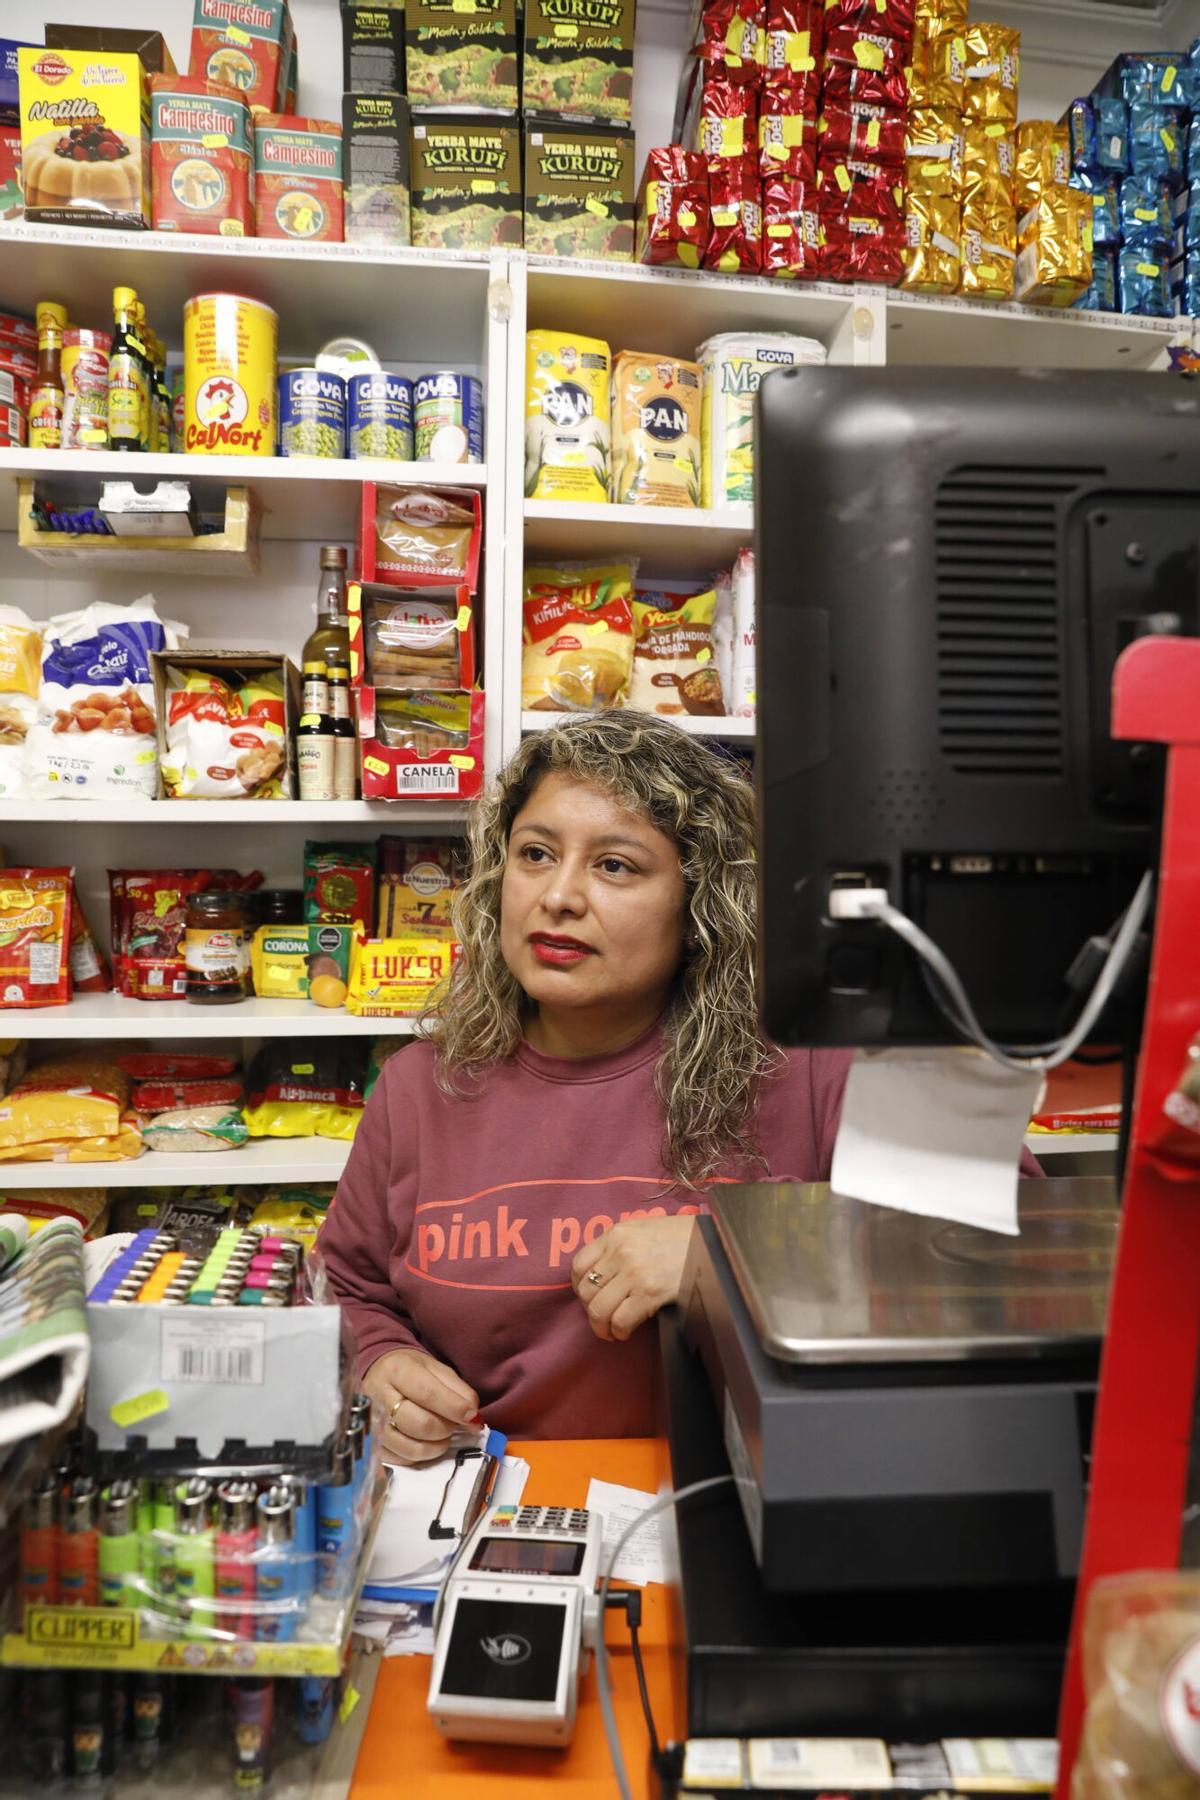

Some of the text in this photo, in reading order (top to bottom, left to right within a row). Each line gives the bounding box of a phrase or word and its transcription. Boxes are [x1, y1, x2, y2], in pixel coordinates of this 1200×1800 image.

[201, 0, 273, 29] Campesino
[857, 31, 894, 53] noel
[34, 64, 72, 74] El Dorado
[28, 98, 99, 121] Natilla
[158, 104, 236, 135] Campesino
[262, 138, 337, 168] Campesino
[427, 135, 503, 150] YERBA MATE
[543, 142, 618, 158] YERBA MATE
[757, 350, 794, 364] GOYA
[293, 378, 342, 401] GOYA
[359, 381, 409, 403] GOYA
[186, 421, 262, 452] CalNort
[659, 633, 671, 645] DE
[403, 766, 455, 778] CANELA
[416, 902, 437, 922] 7
[264, 940, 310, 952] CORONA
[372, 956, 443, 979] LUKER
[418, 1205, 530, 1272] pink
[35, 1618, 127, 1640] CLIPPER
